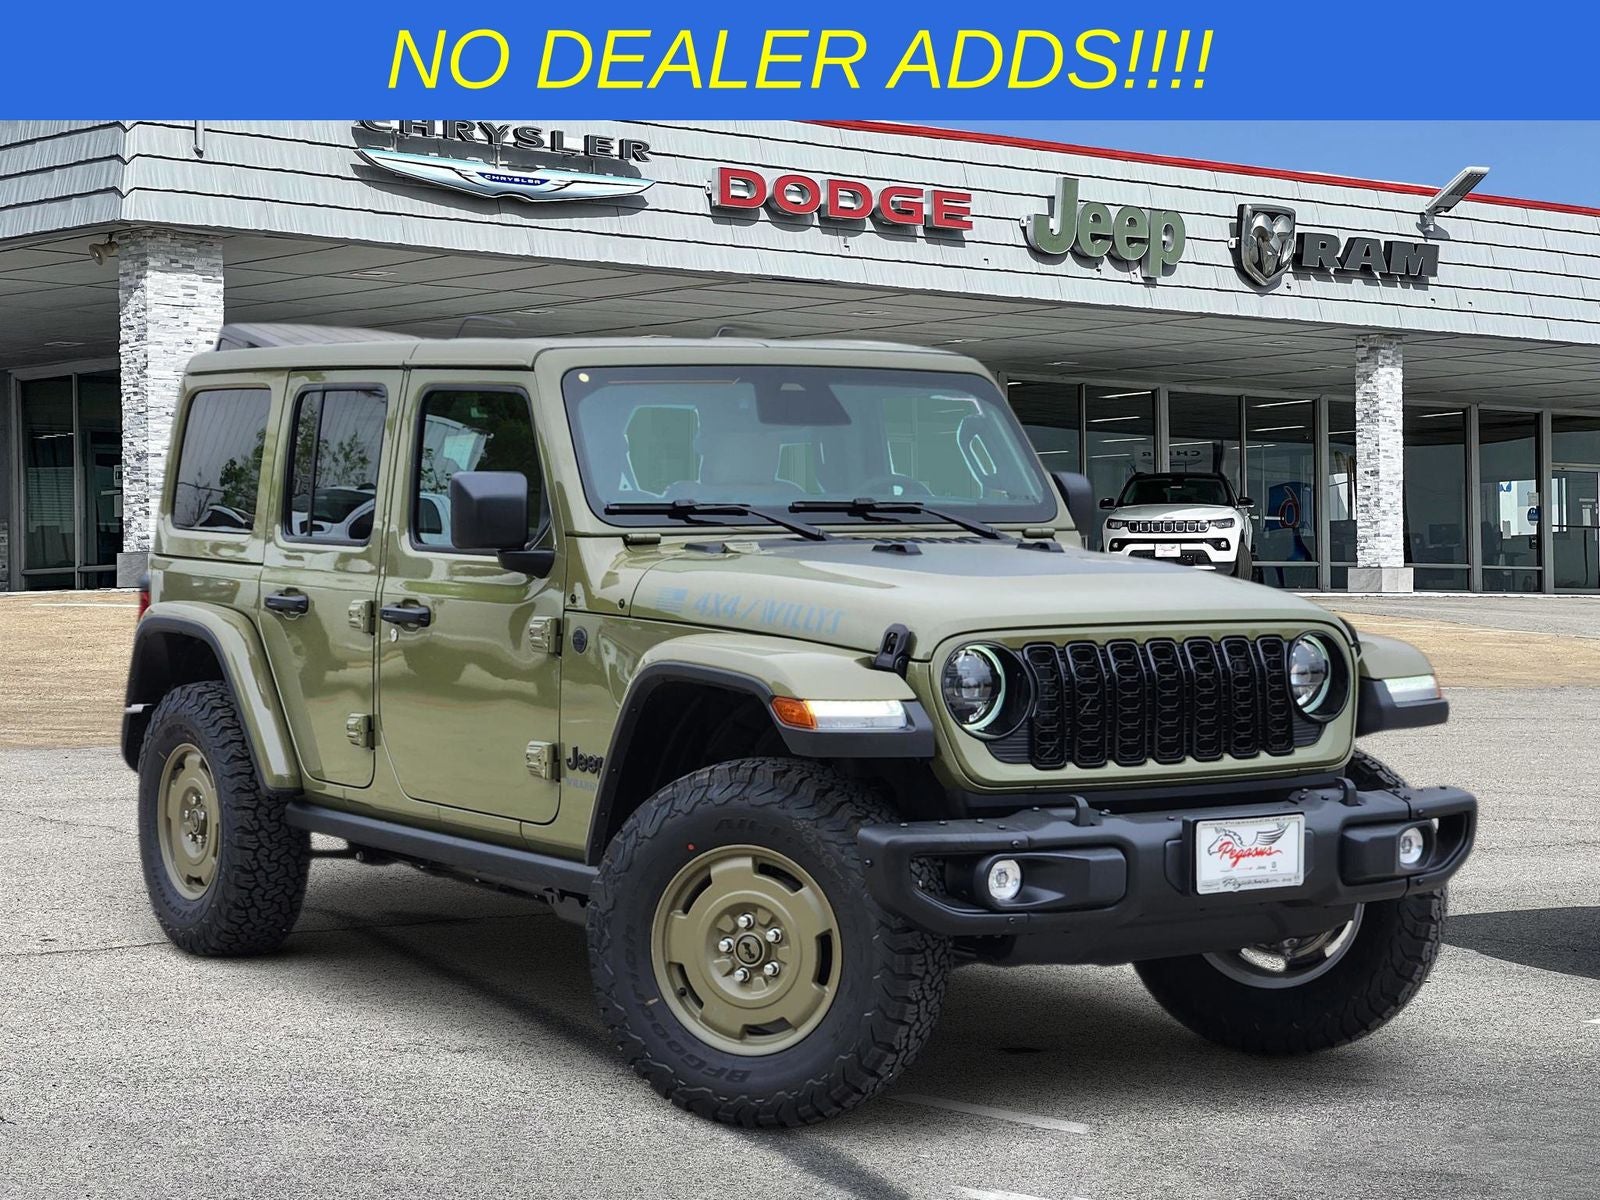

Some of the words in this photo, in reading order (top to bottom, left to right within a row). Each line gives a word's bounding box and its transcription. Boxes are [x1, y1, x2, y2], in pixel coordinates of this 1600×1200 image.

[357, 120, 651, 162] CHRYSLER
[484, 174, 541, 185] CHRYSLER
[713, 166, 974, 231] DODGE
[1027, 177, 1186, 278] Jeep
[1297, 232, 1440, 279] RAM
[1218, 841, 1283, 868] Pegasus
